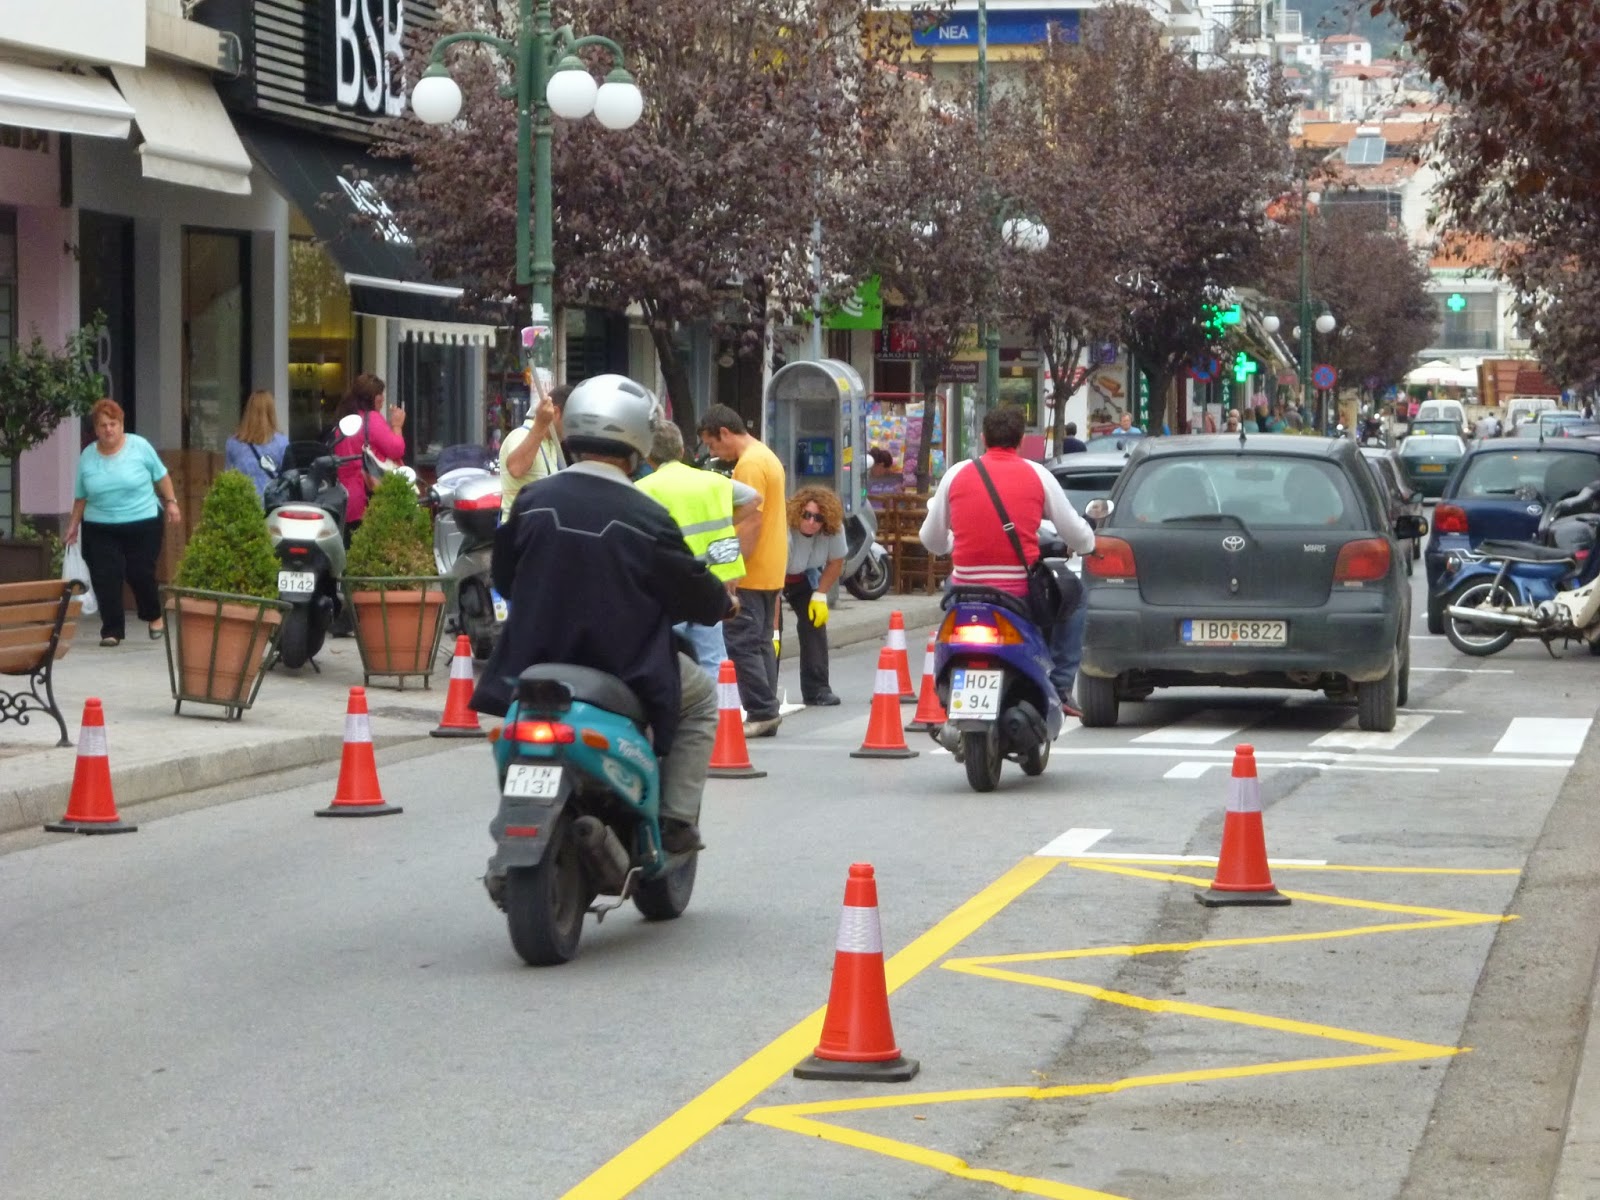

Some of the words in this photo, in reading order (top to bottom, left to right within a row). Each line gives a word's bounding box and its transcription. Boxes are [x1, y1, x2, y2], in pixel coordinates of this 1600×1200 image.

[939, 25, 968, 40] ΝΕΑ
[280, 579, 313, 591] 9142
[966, 674, 999, 690] HOZ
[968, 694, 990, 710] 94
